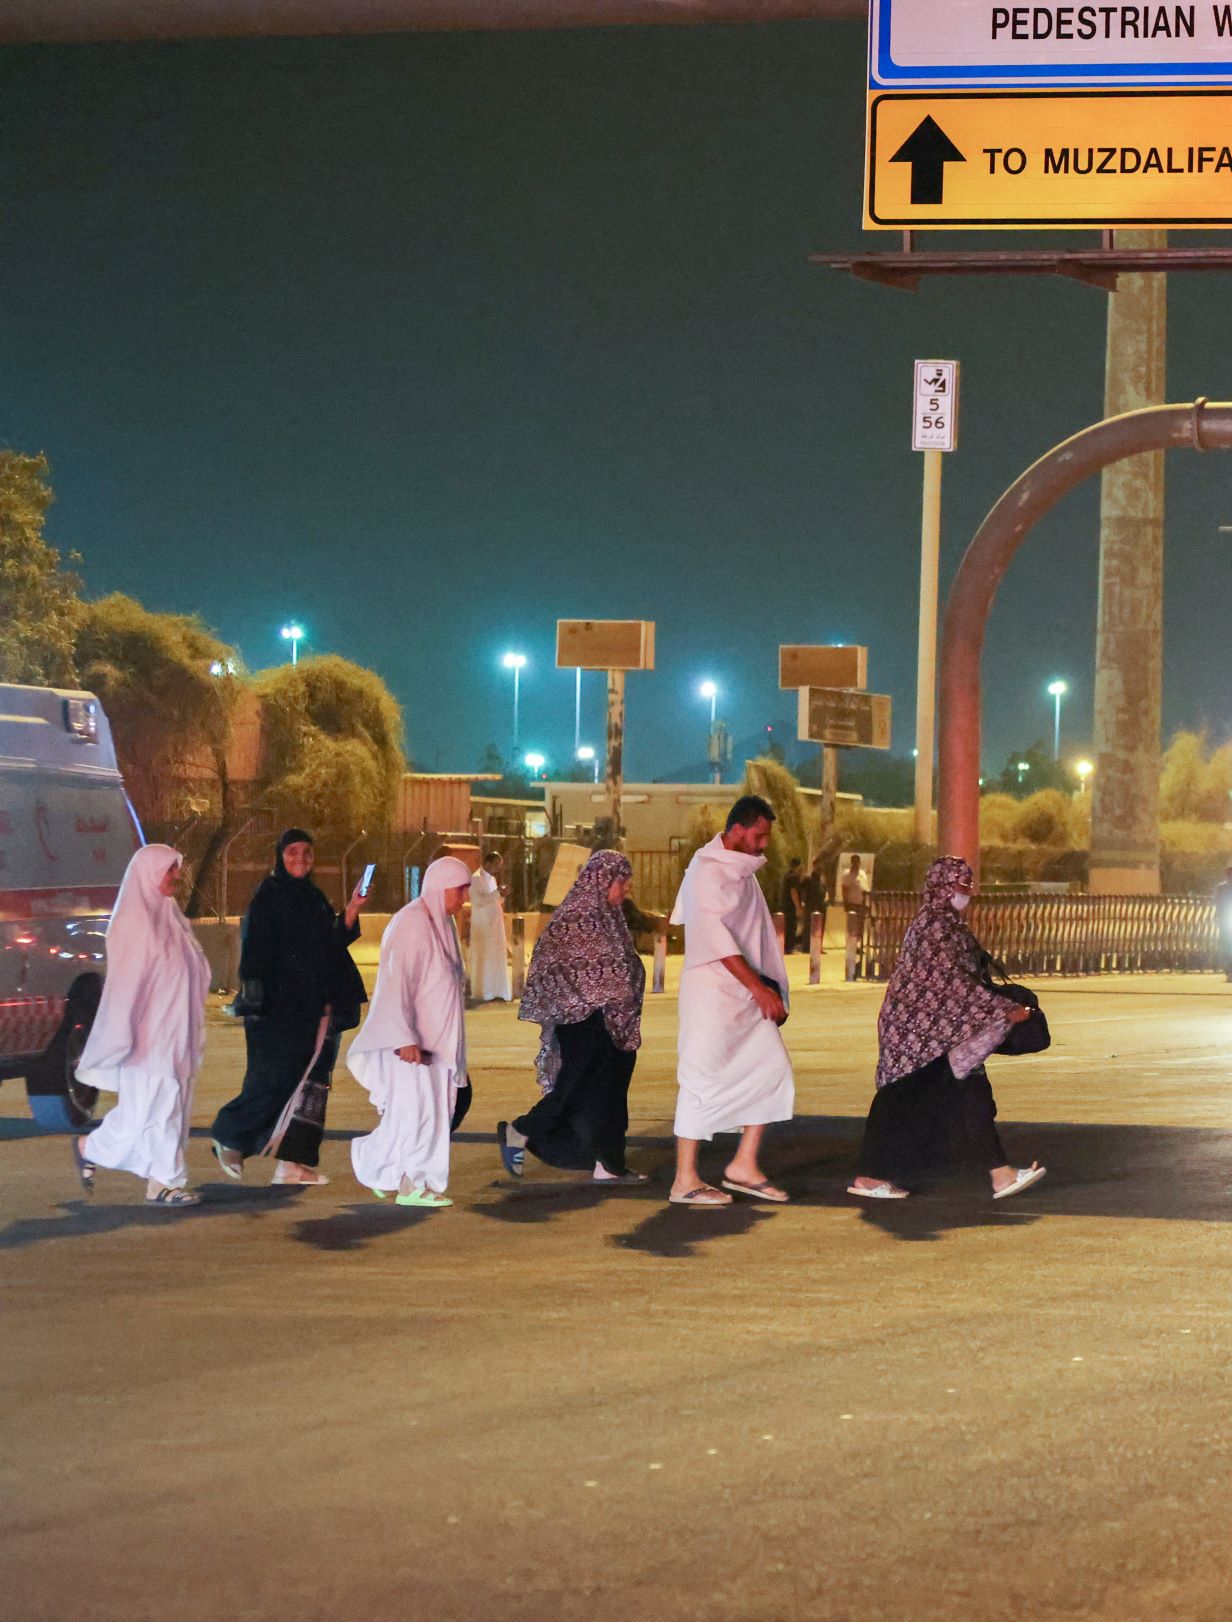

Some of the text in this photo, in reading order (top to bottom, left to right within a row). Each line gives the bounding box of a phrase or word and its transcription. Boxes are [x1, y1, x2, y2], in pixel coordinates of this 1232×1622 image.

[991, 5, 1195, 40] PEDESTRIAN
[983, 147, 1027, 175] TO
[929, 398, 940, 412] 5
[922, 416, 945, 429] 56
